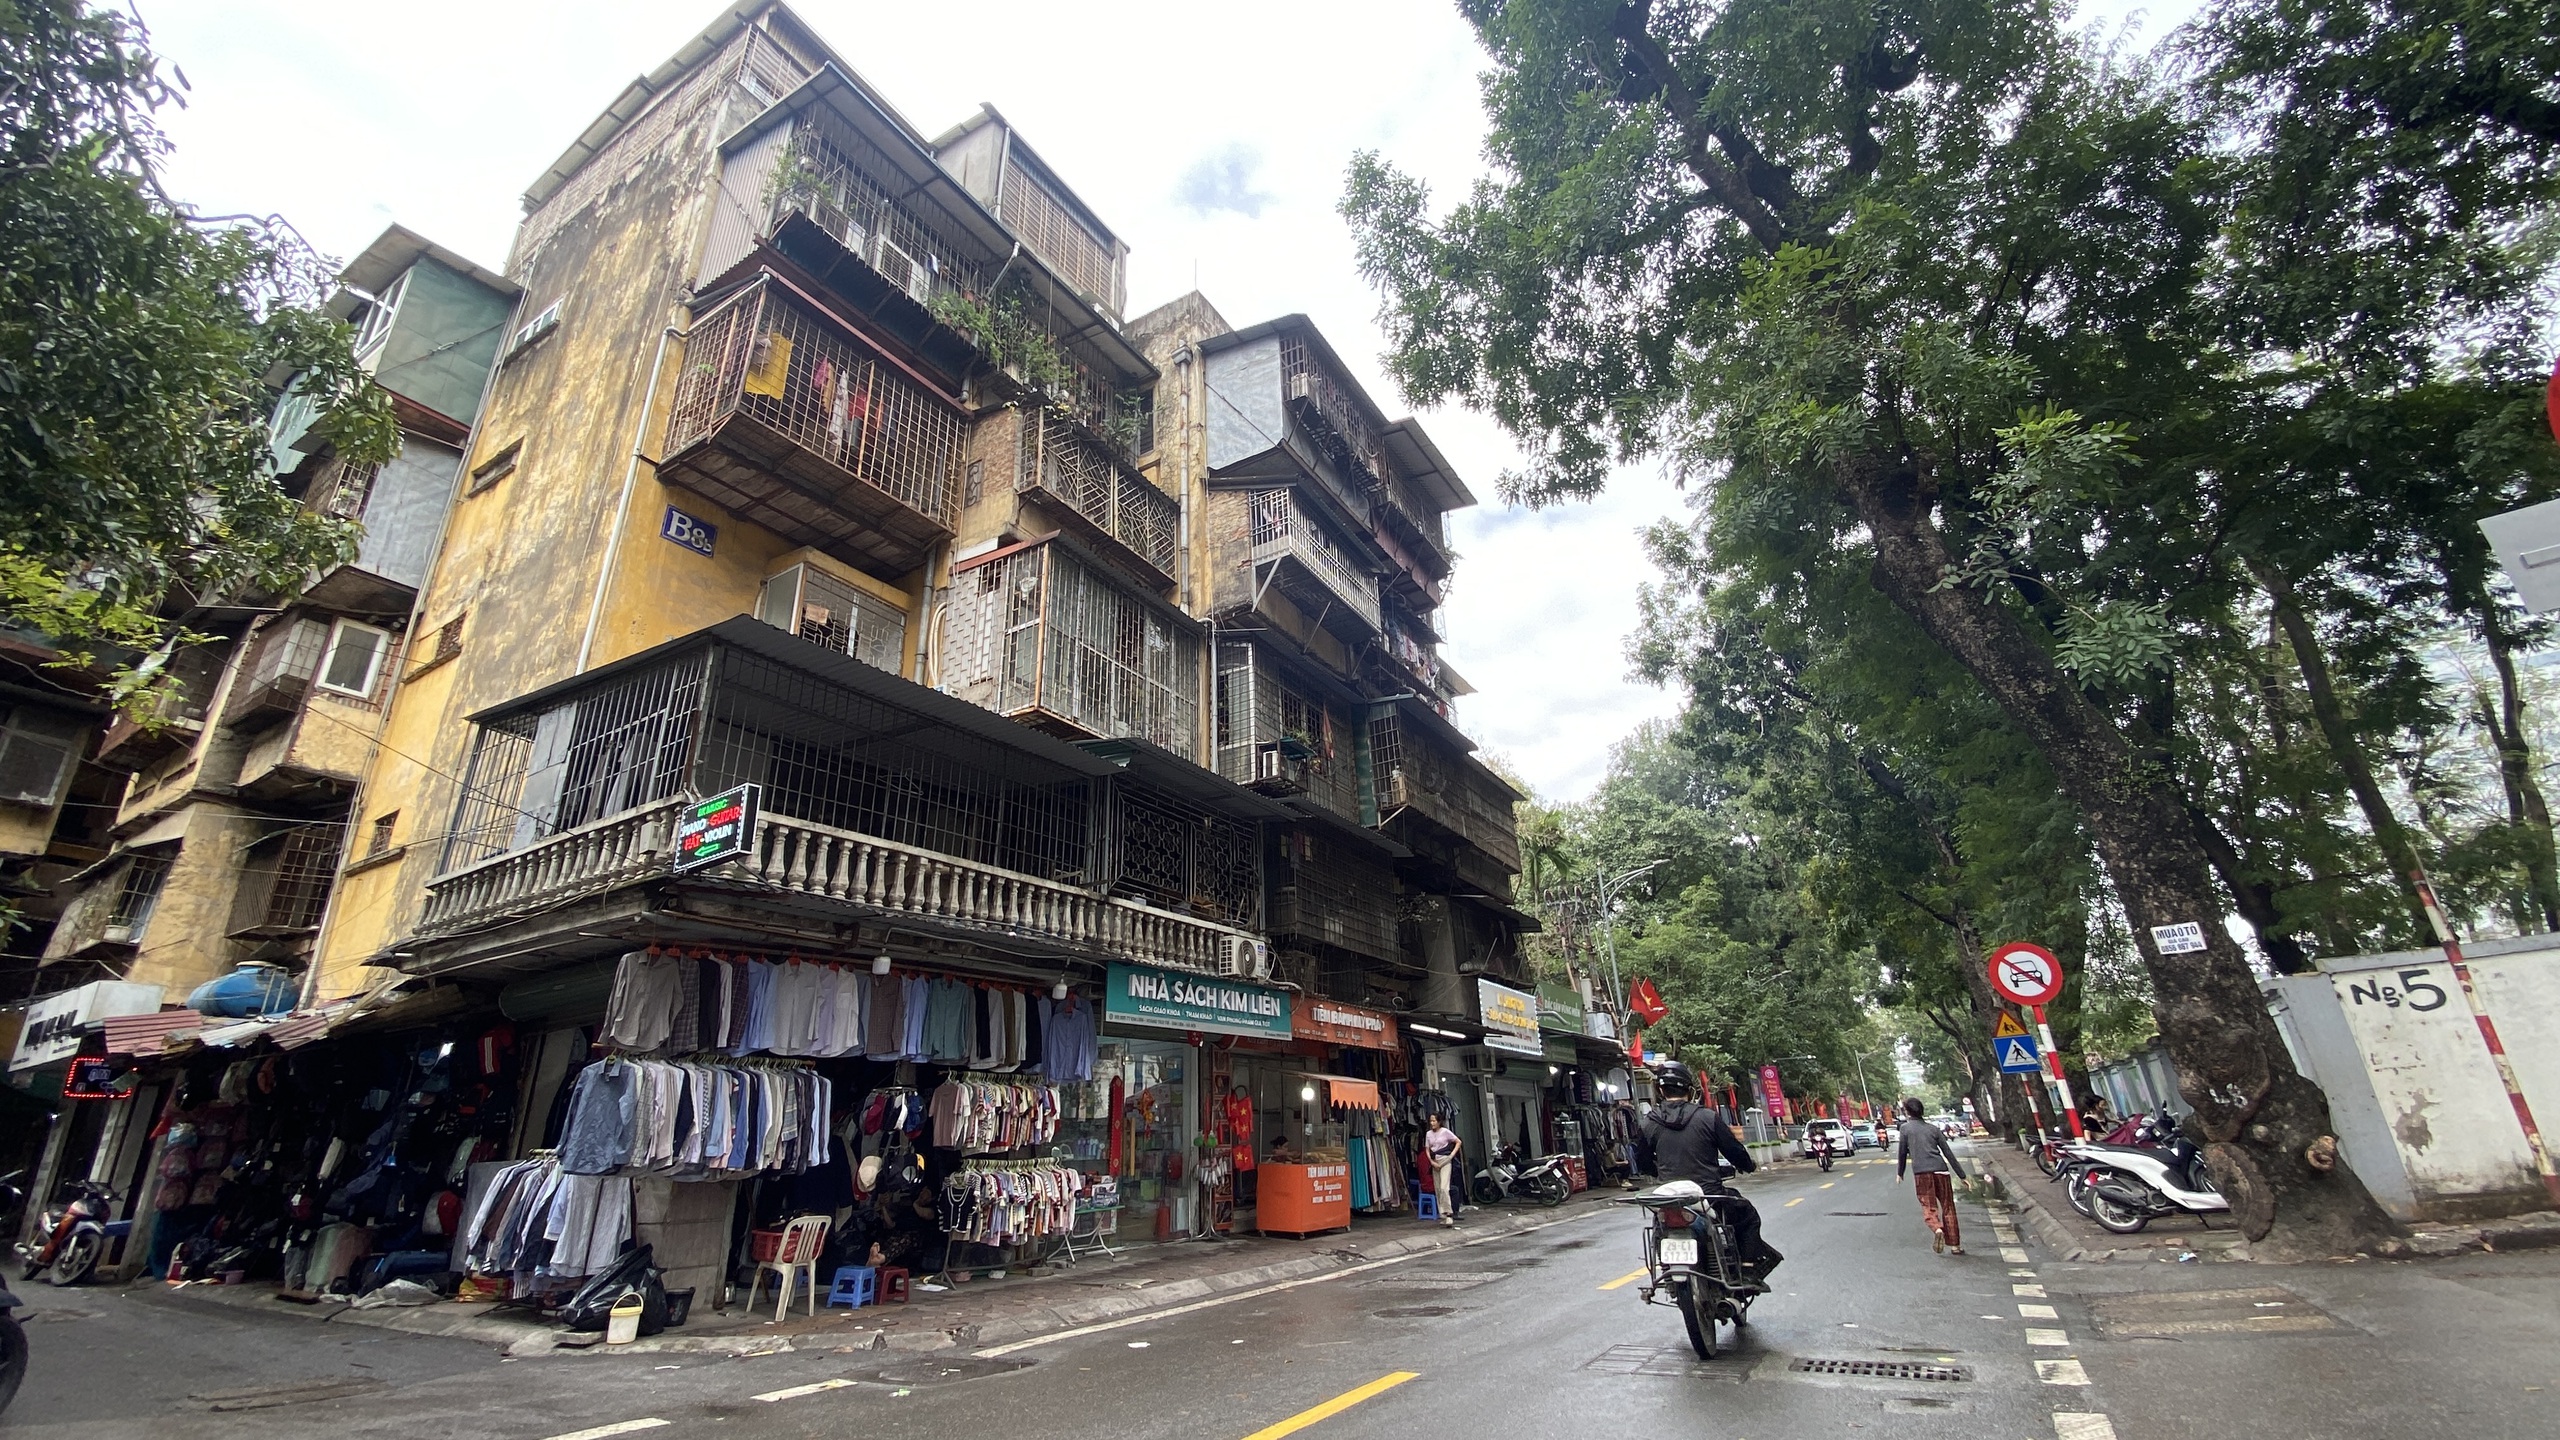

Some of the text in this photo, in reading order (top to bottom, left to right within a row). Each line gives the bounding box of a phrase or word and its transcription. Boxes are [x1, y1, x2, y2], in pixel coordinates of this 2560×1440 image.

[682, 806, 741, 837] PIANO GUITAR
[704, 824, 733, 844] VIOLIN
[1128, 972, 1281, 1017] NHÀ SÁCH KIM LIÊN
